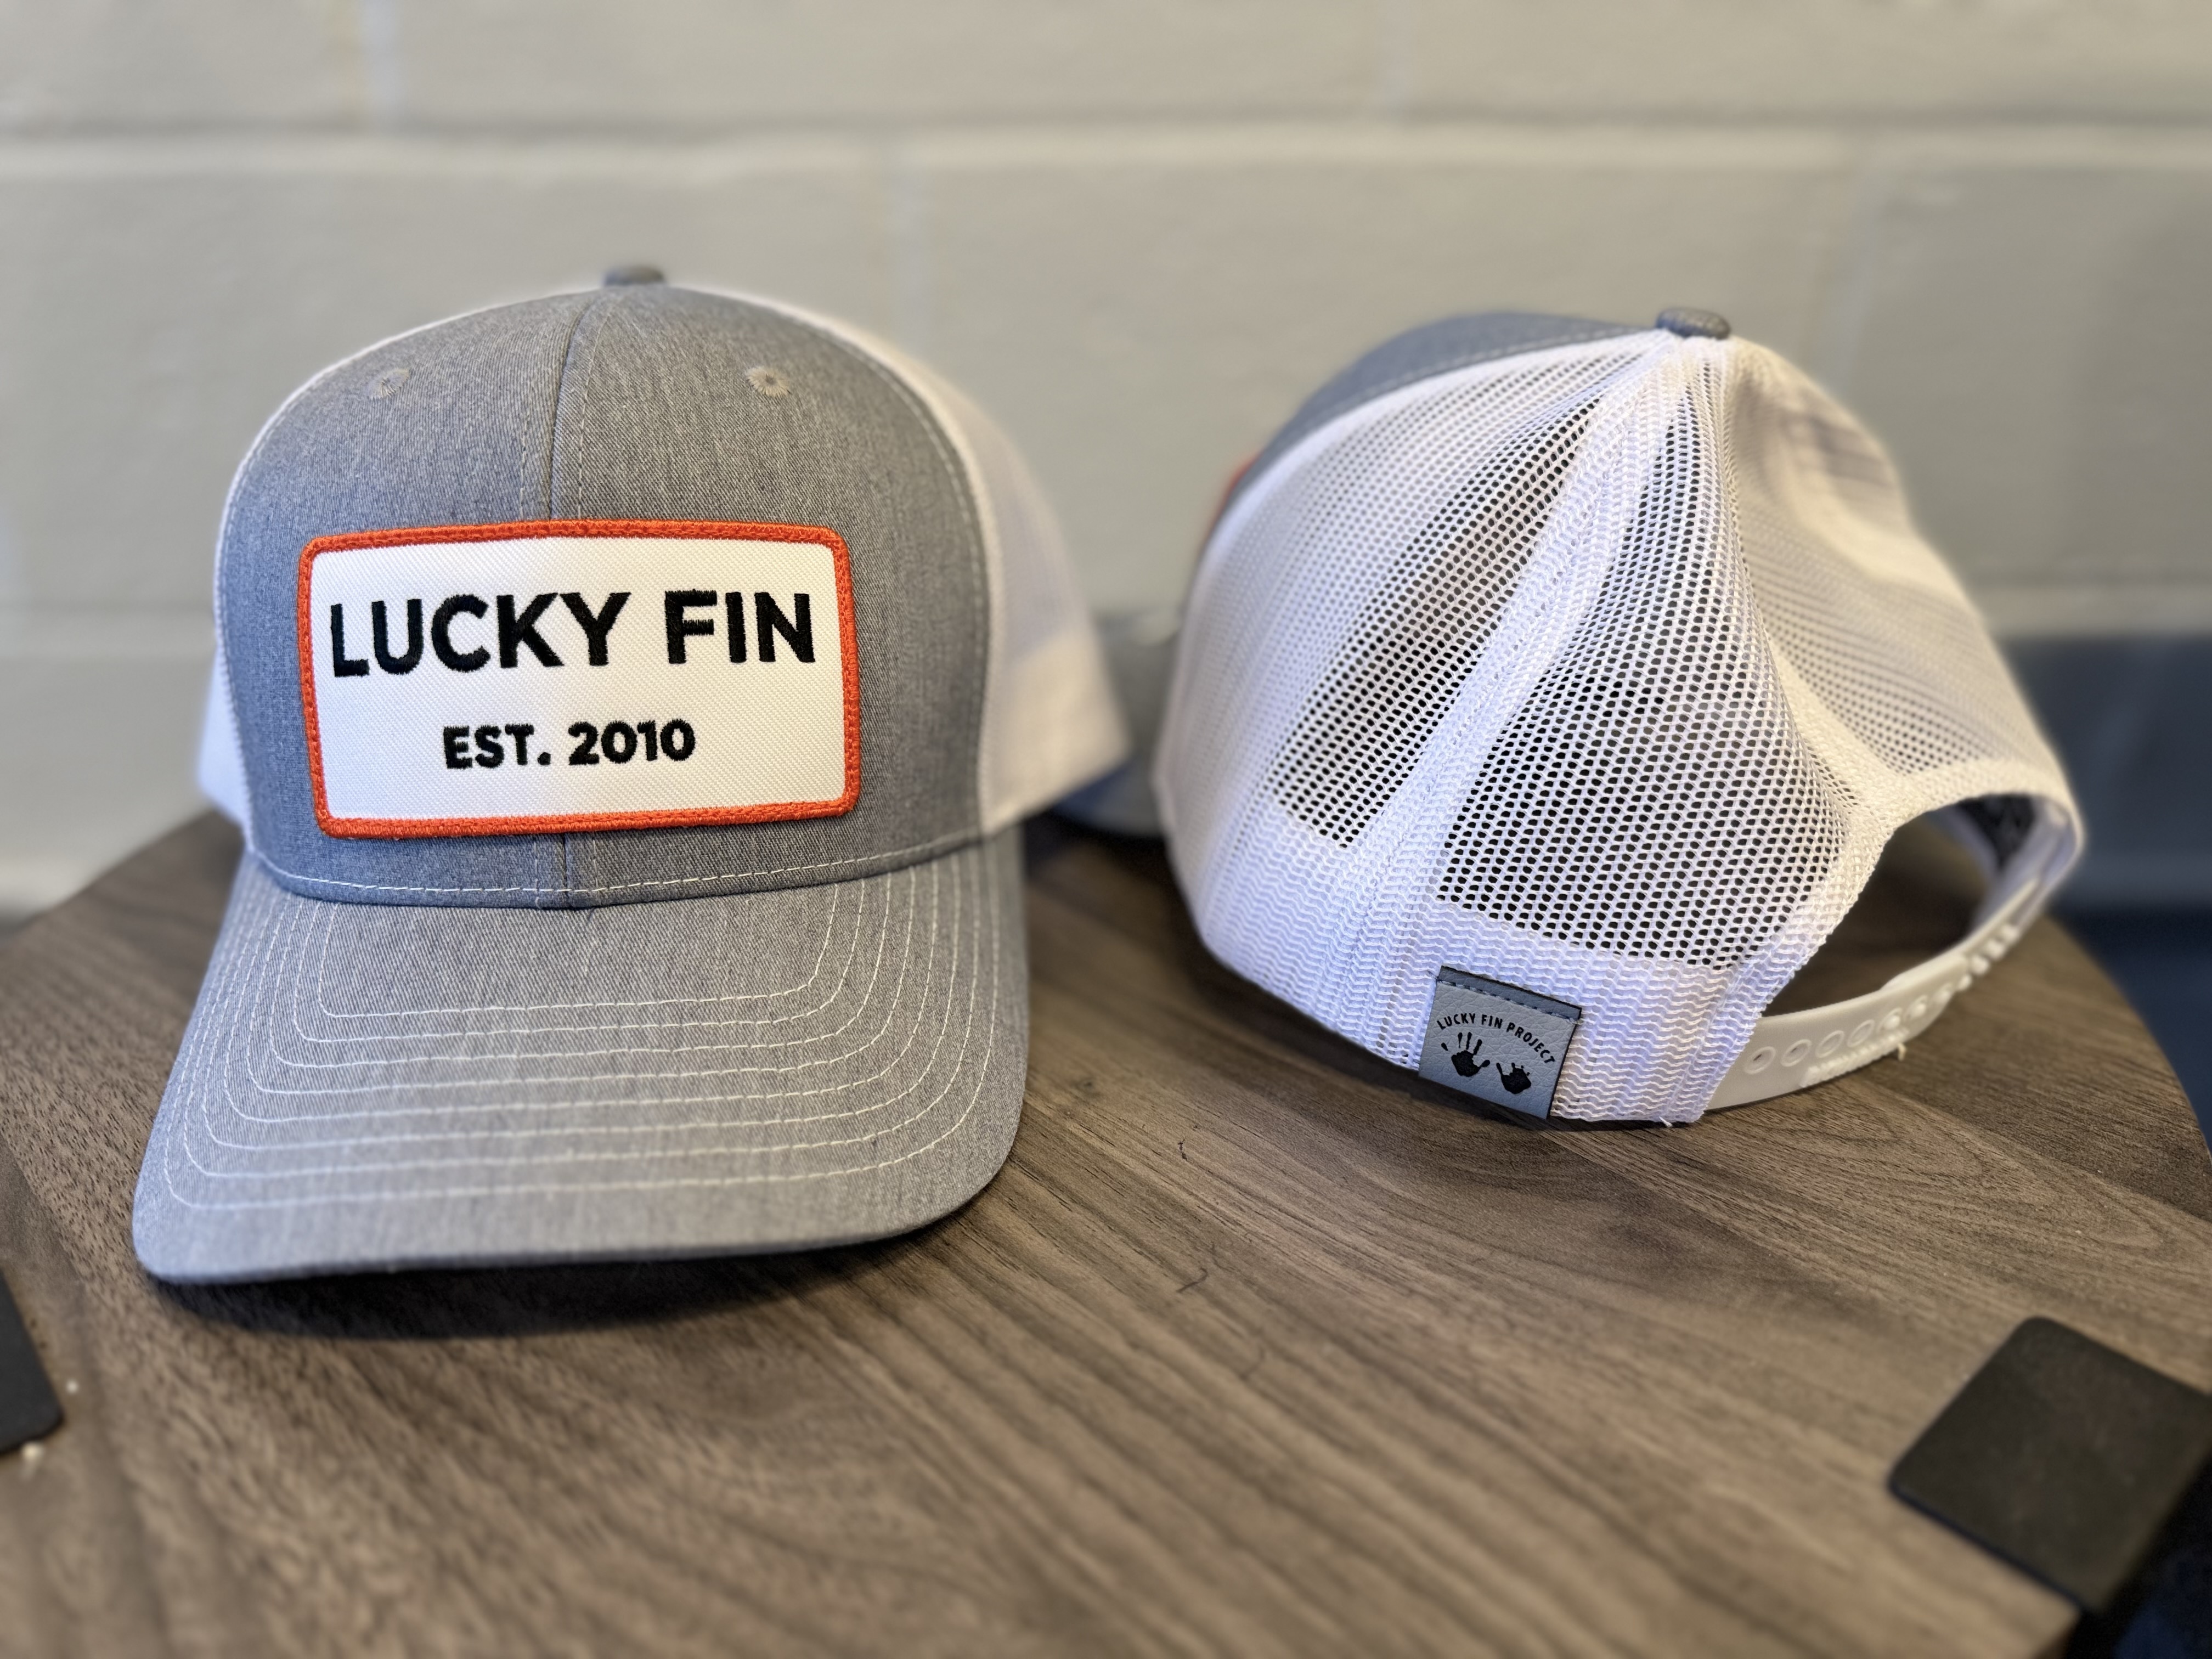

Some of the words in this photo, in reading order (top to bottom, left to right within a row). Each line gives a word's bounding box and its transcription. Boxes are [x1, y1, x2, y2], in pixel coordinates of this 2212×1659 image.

[330, 591, 631, 678] LUCKY
[664, 588, 816, 664] FIN
[443, 723, 551, 770] EST.
[568, 718, 696, 766] 2010
[1436, 1013, 1476, 1030] LUCKY
[1481, 1014, 1503, 1029] FIN
[1506, 1022, 1556, 1064] PROJECT
